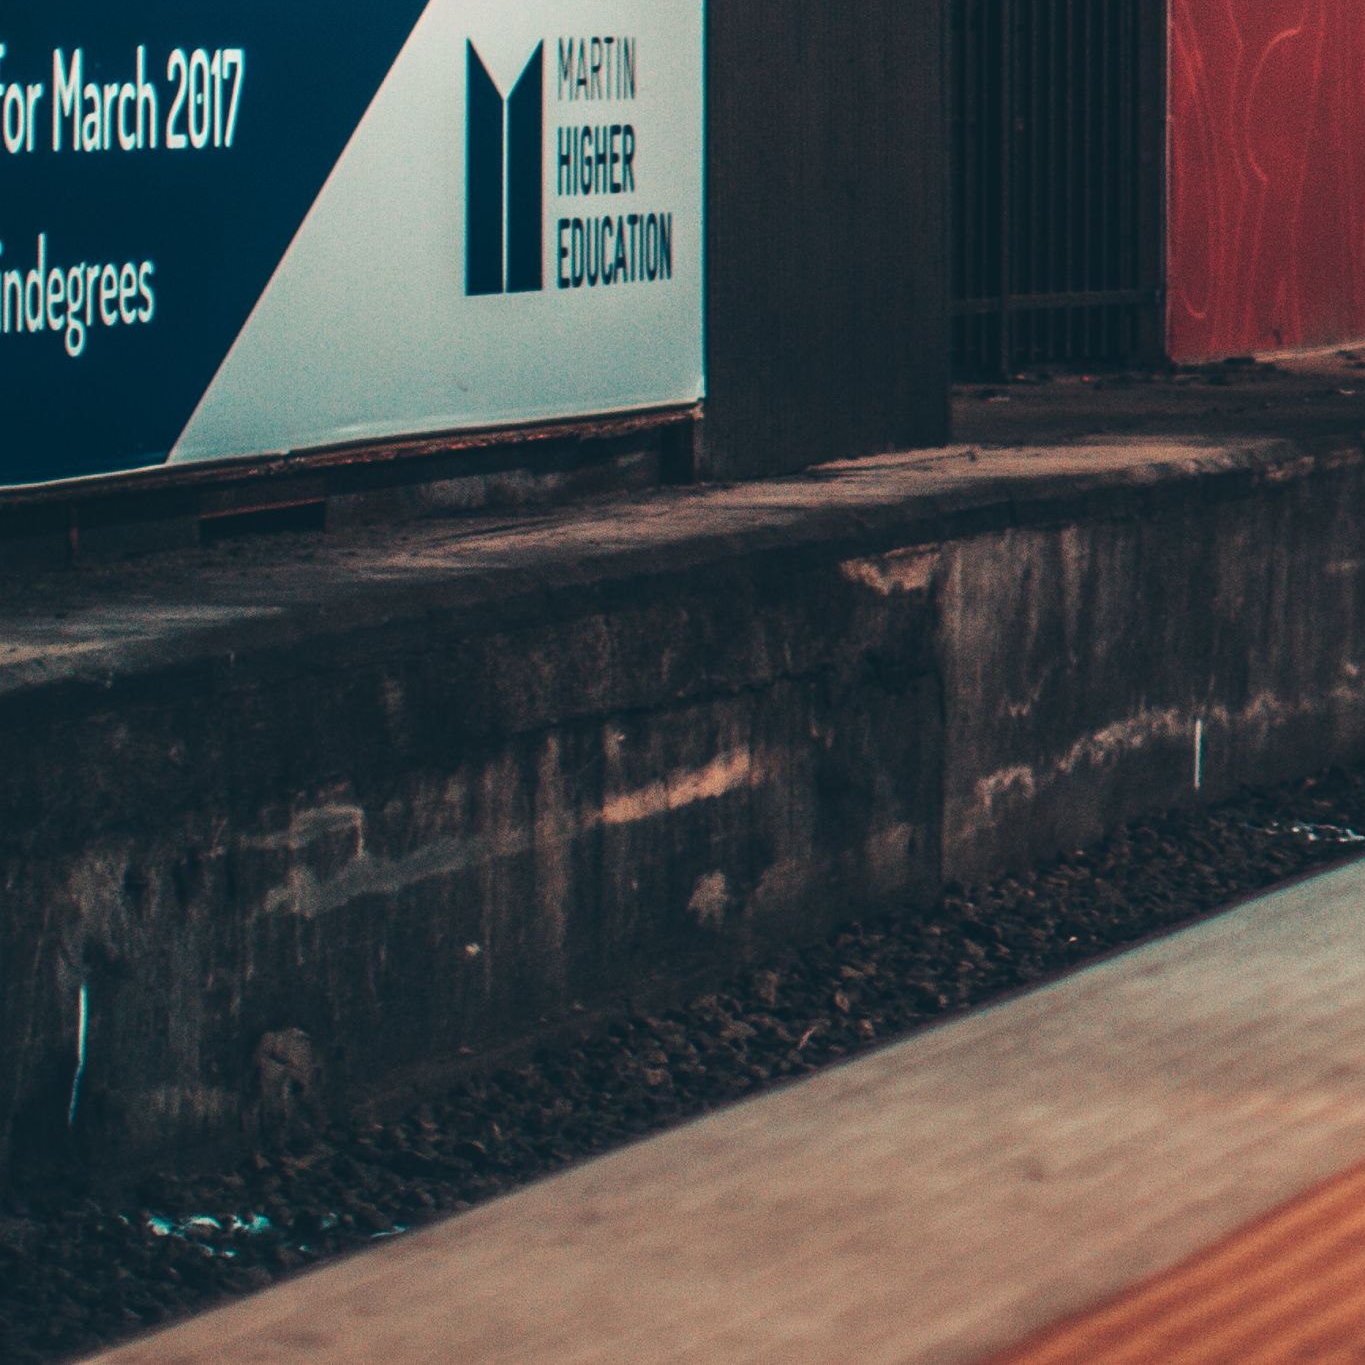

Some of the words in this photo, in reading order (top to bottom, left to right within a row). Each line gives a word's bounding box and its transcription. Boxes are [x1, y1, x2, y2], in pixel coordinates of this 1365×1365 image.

[52, 44, 157, 151] March
[165, 48, 244, 150] 2017
[557, 36, 637, 102] MARTIN
[556, 124, 636, 197] HIGHER
[556, 211, 673, 290] EDUCATION
